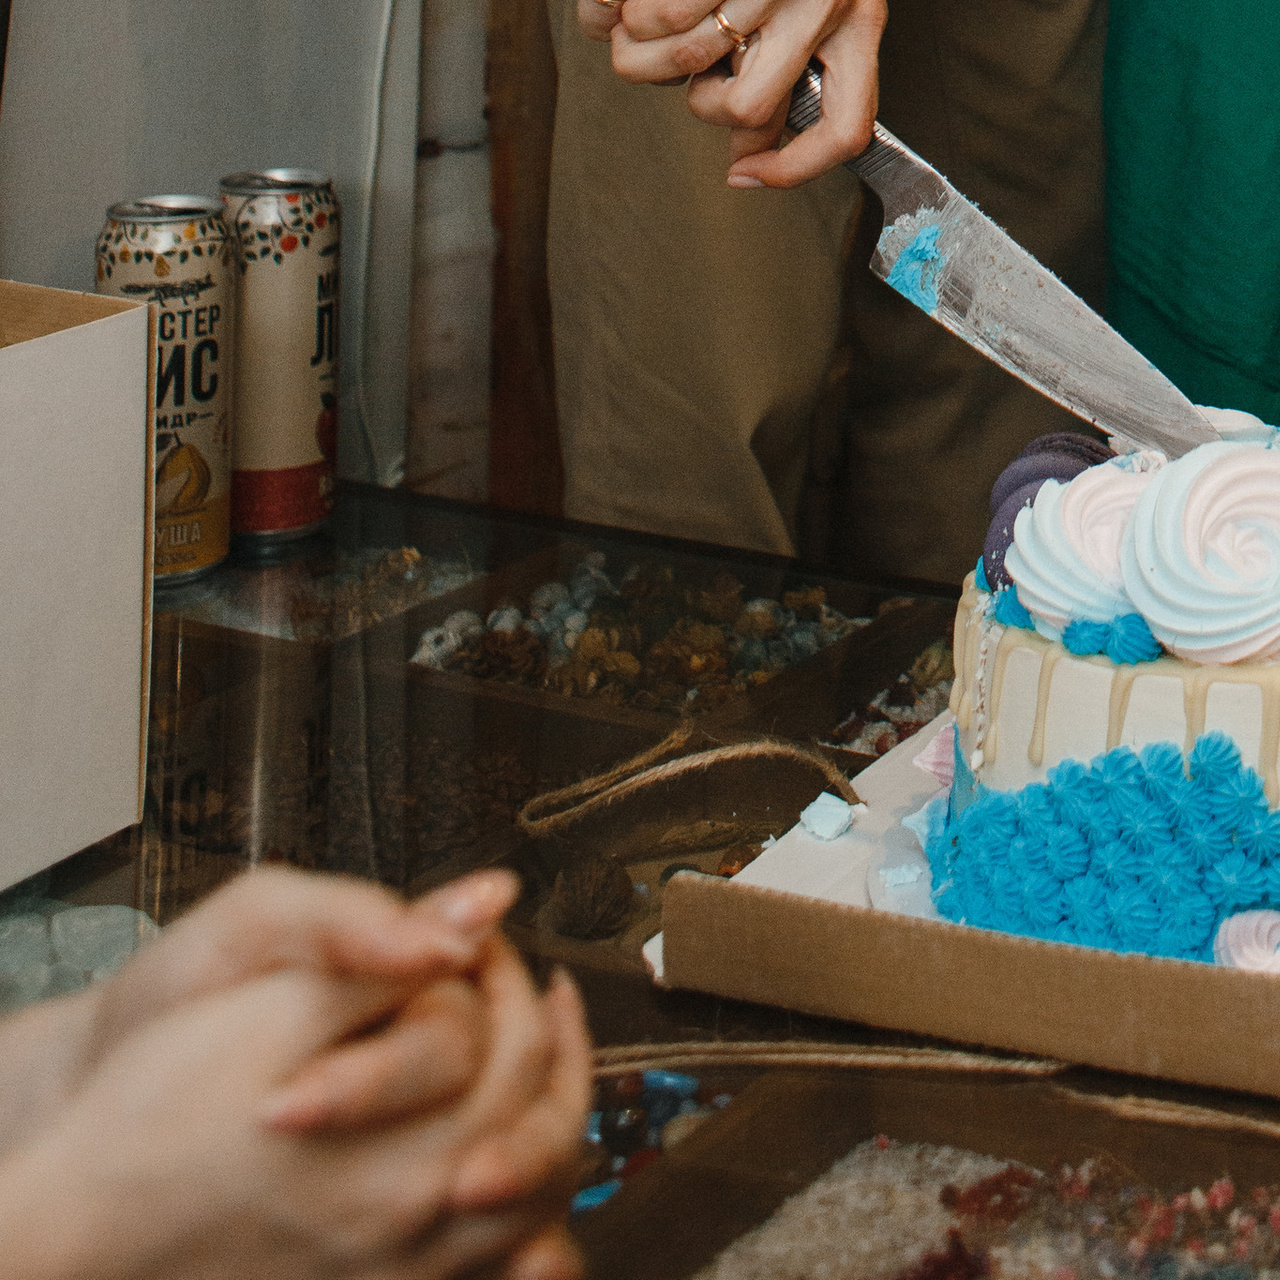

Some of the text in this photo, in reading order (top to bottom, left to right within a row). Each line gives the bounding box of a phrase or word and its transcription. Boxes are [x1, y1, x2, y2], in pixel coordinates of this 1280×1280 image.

[158, 304, 220, 341] СТЕР
[155, 338, 218, 408] ИС
[155, 412, 198, 430] ИДР
[156, 521, 201, 548] УША
